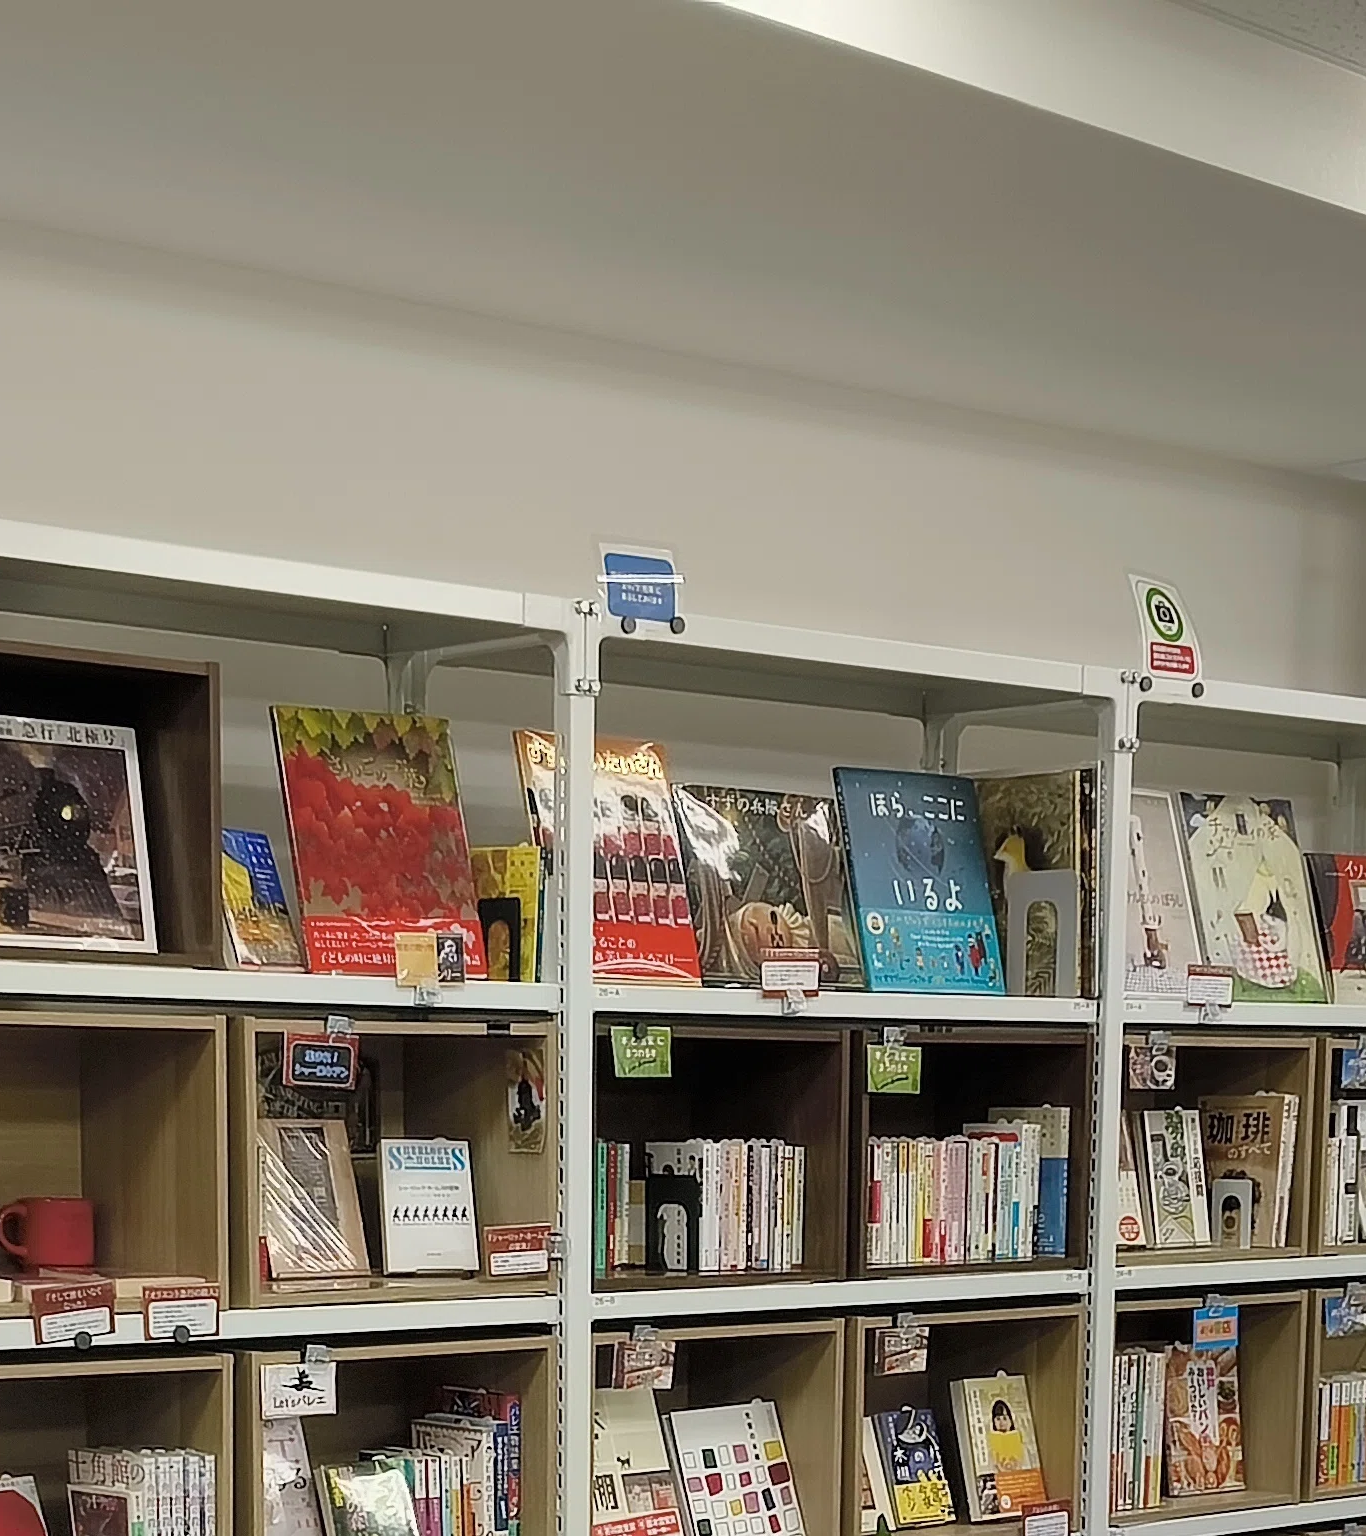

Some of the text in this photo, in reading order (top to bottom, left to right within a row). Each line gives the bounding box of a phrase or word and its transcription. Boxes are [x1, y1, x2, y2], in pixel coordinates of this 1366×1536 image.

[870, 792, 966, 822] ほら、ここに
[892, 878, 964, 911] いるよ
[1207, 1112, 1272, 1145] 珈琲
[1227, 1143, 1272, 1159] のすべて
